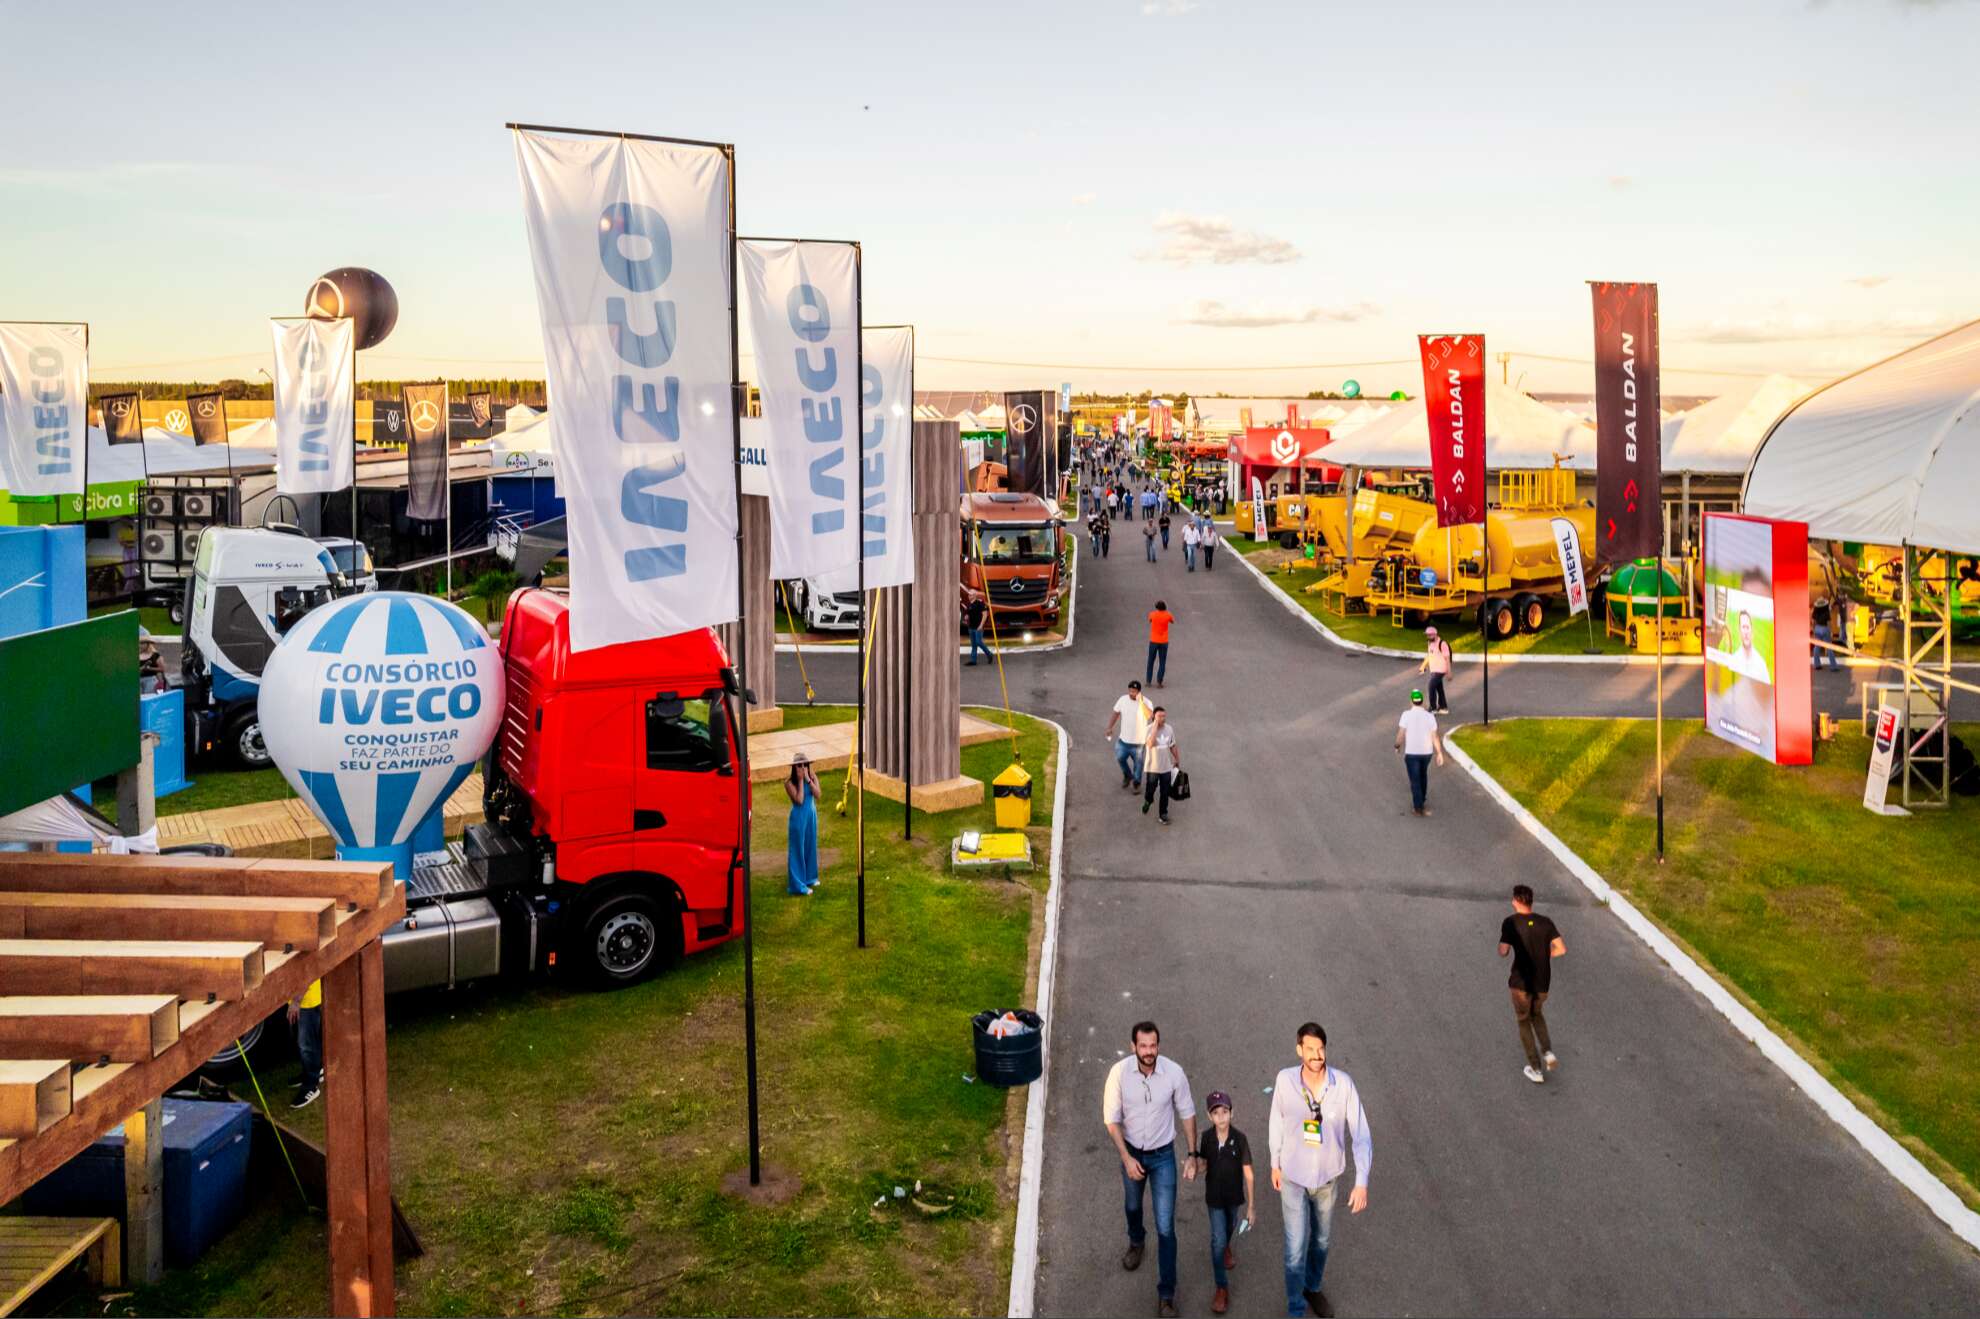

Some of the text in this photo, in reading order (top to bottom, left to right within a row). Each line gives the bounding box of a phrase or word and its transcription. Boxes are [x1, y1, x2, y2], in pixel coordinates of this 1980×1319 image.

[1621, 332, 1638, 462] BALDAN
[1447, 369, 1464, 459] BALDAN
[1562, 531, 1578, 585] MEPEL
[326, 659, 477, 683] CONSÓRCIO
[319, 683, 481, 726] IVECO
[344, 729, 459, 746] CONQUISTAR
[351, 743, 451, 758] FAZ PARTE DO
[340, 759, 371, 770] SEU
